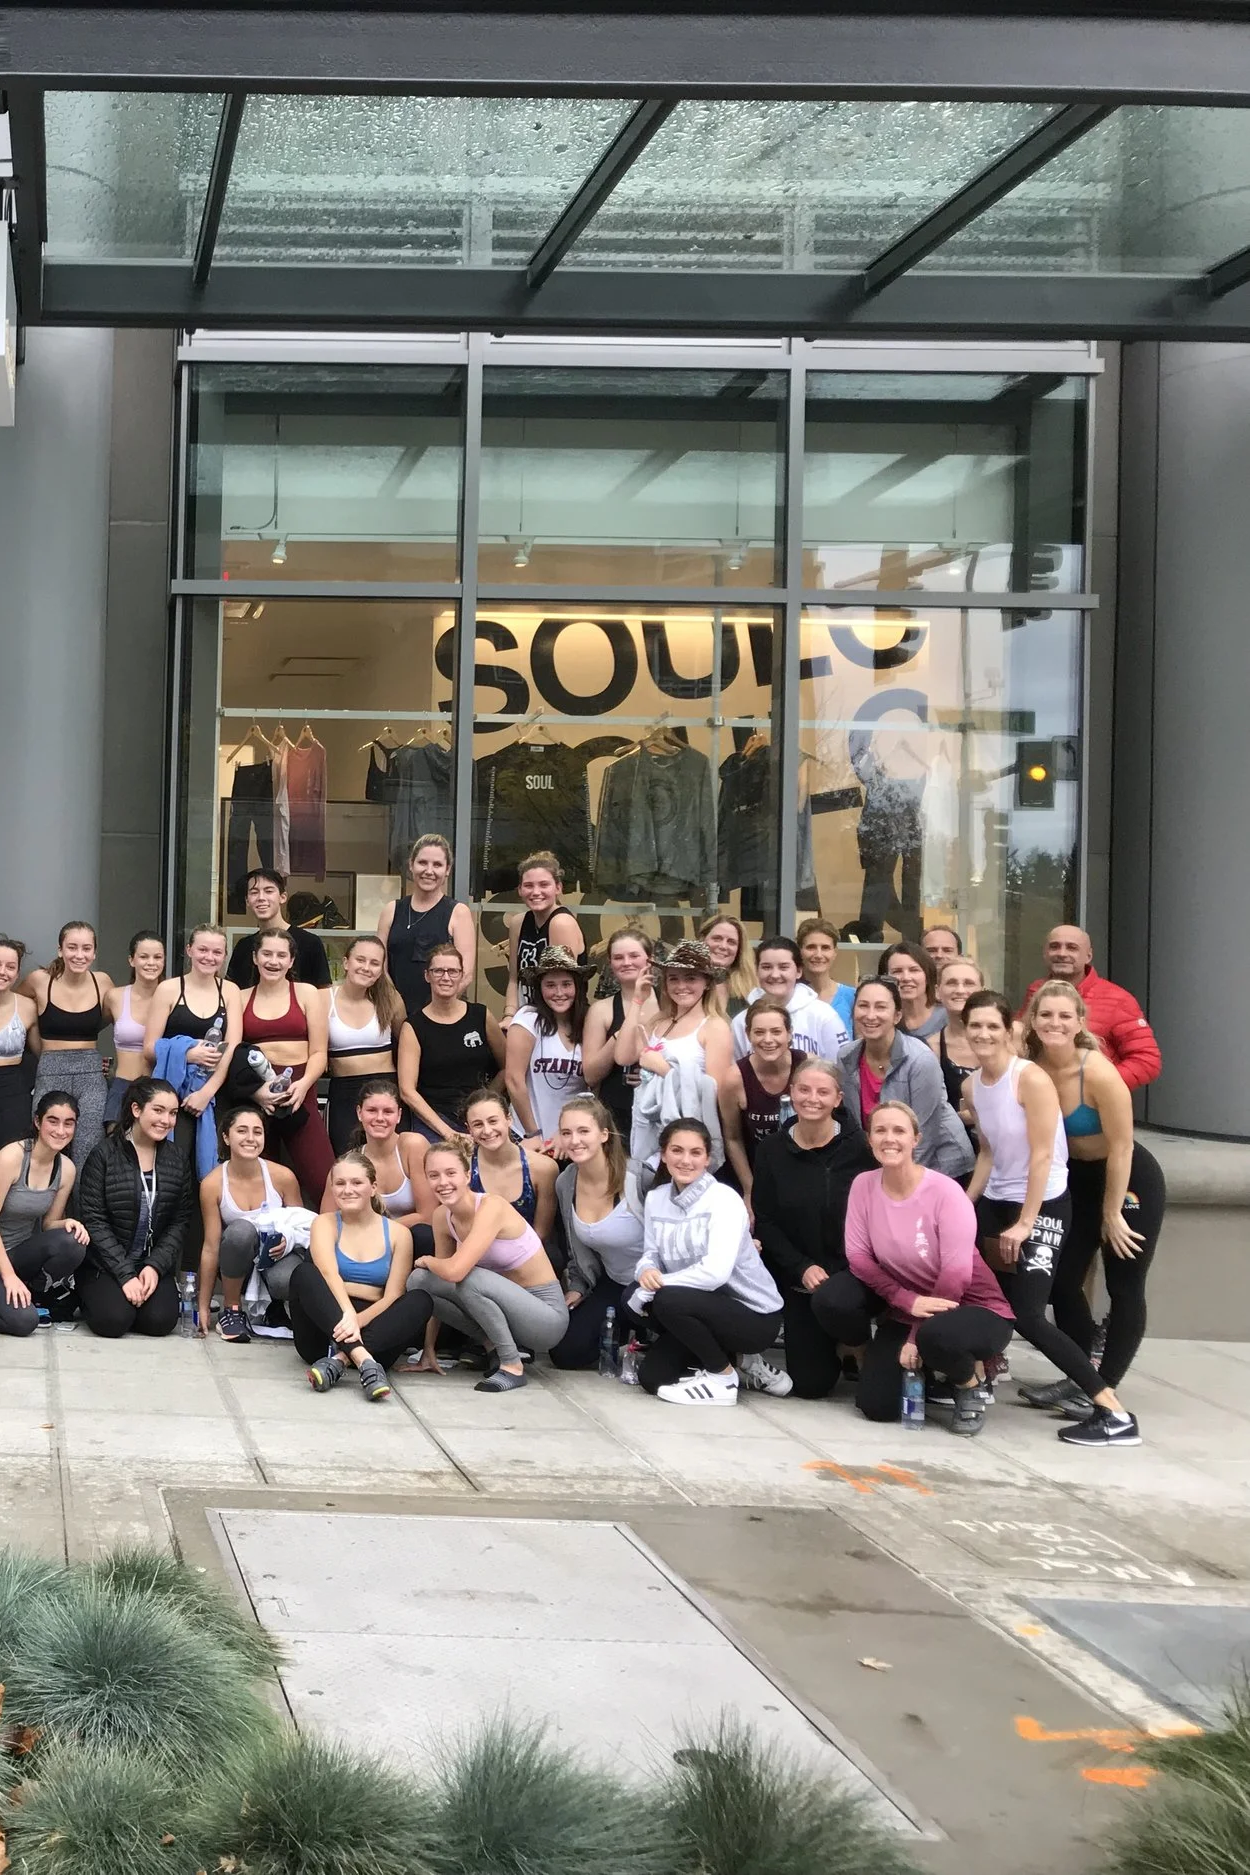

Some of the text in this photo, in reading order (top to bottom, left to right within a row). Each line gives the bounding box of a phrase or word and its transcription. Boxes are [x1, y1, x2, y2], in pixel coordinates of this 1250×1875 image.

[525, 774, 555, 790] SOUL
[764, 1113, 780, 1121] THE
[1034, 1215, 1065, 1233] SOUL
